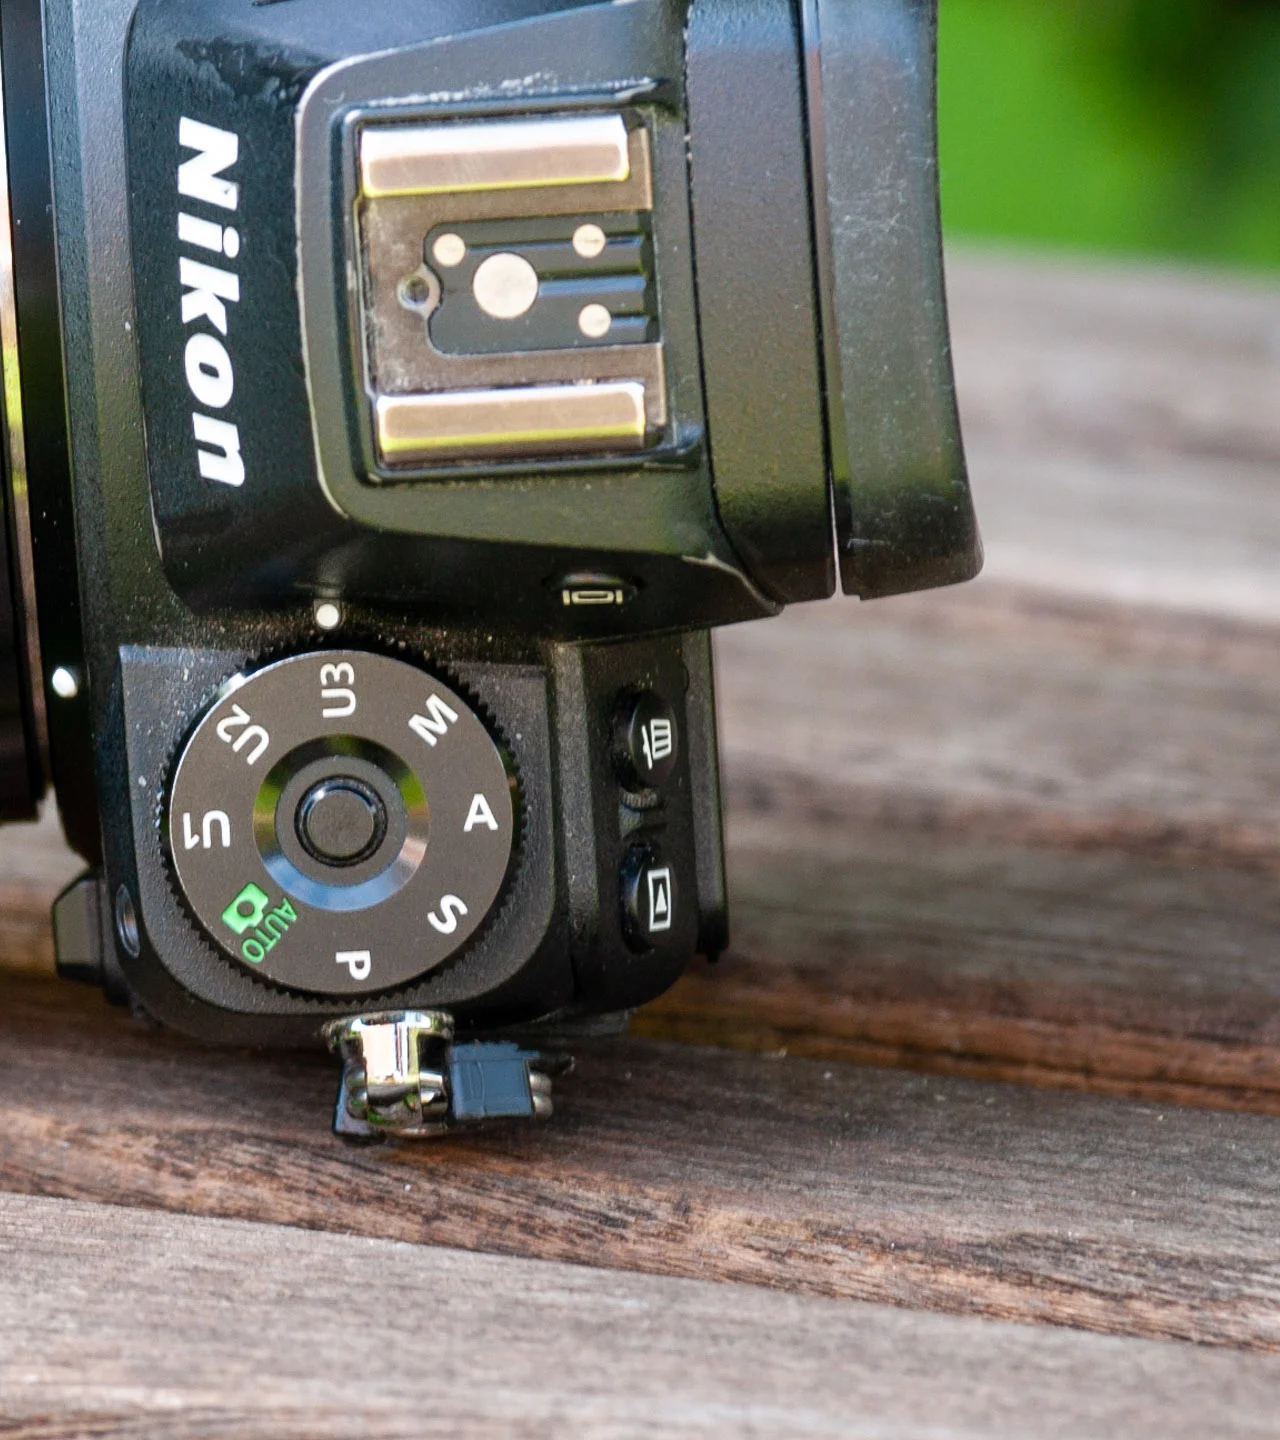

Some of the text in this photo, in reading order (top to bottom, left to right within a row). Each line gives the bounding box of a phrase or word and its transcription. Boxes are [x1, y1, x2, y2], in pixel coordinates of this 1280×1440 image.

[178, 116, 245, 486] Nikon
[321, 663, 356, 717] U3
[216, 705, 269, 765] U2
[409, 694, 458, 746] M
[183, 811, 230, 849] U1
[464, 794, 498, 831] A
[243, 898, 298, 962] AUTO
[428, 895, 467, 933] S
[336, 951, 371, 980] P
